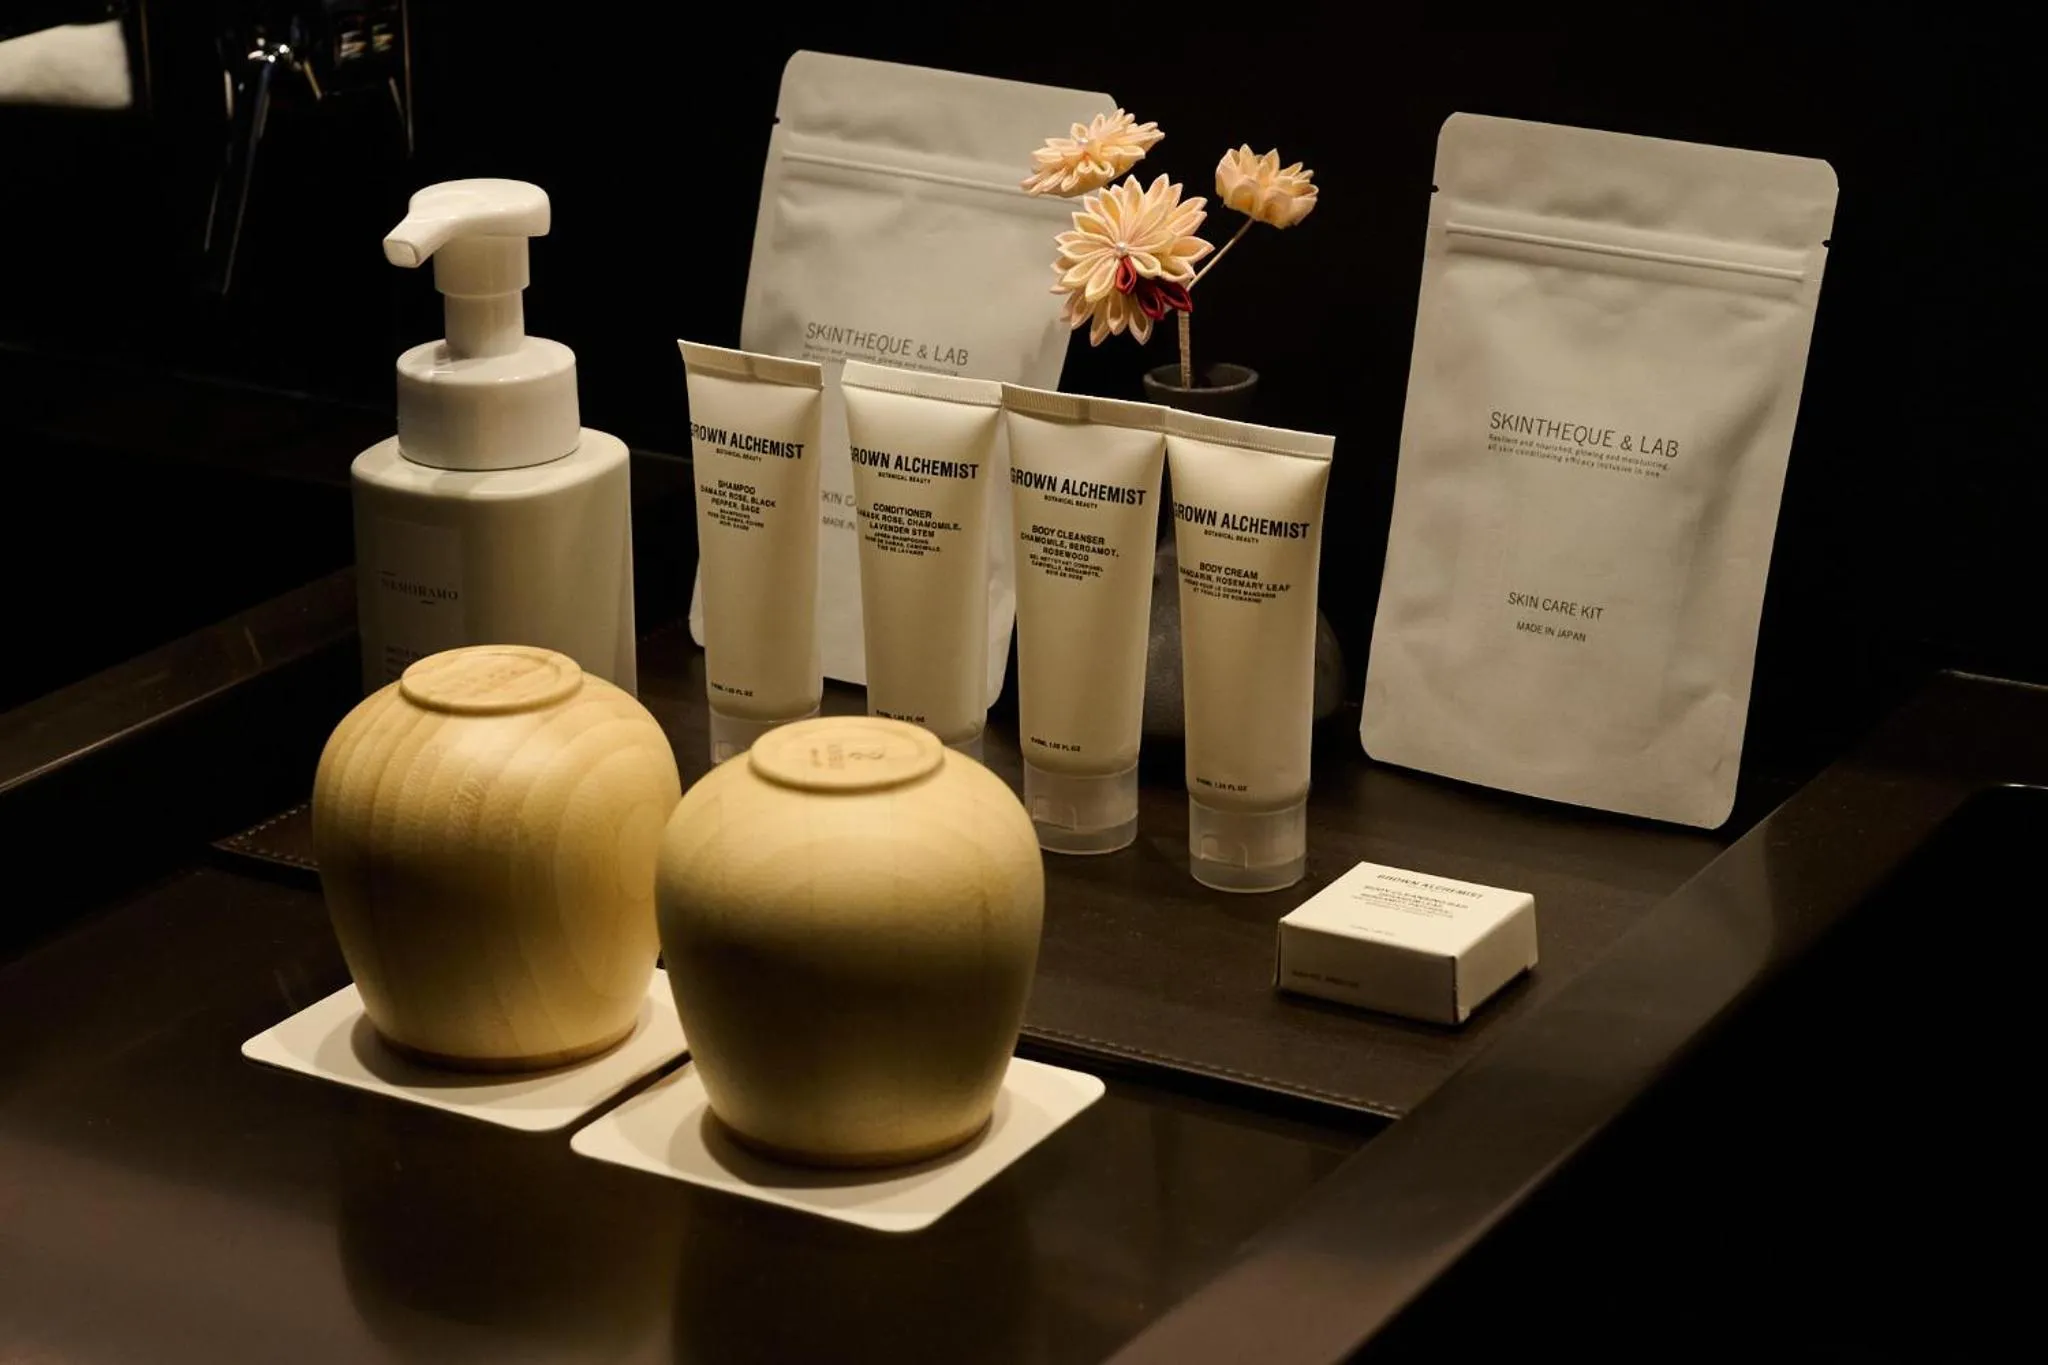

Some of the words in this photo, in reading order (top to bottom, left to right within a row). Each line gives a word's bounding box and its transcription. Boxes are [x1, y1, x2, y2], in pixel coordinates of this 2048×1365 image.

[806, 321, 913, 356] SKINTHEQUE
[917, 343, 928, 359] &
[934, 345, 969, 366] LAB
[690, 422, 728, 445] ROWN
[730, 432, 805, 460] ALCHEMIST
[1490, 411, 1616, 448] SKINTHEQUE
[1620, 434, 1633, 452] &
[1641, 435, 1679, 458] LAB
[851, 444, 890, 469] ROWN
[894, 455, 979, 480] ALCHEMIST
[718, 480, 756, 495] SHAMPOO
[1061, 478, 1147, 506] ALCHEMIST
[751, 496, 777, 509] BLACK
[822, 490, 842, 505] KIN
[1044, 494, 1074, 506] BOTANICAL
[1076, 500, 1098, 510] BEAUTY
[741, 503, 760, 514] SAGE
[873, 503, 933, 520] CONDITIONER
[869, 521, 910, 535] LAVENDER
[912, 528, 935, 538] STEM
[1032, 524, 1056, 537] BODY
[1057, 529, 1105, 545] CLEANSER
[1221, 512, 1310, 539] ALCHEMIST
[1204, 529, 1234, 541] BOTANICAL
[1236, 535, 1260, 544] BEAUTY
[1043, 546, 1089, 562] ROSEWOOD
[1200, 561, 1223, 574] BODY
[1224, 566, 1258, 580] CREAM
[1216, 575, 1264, 590] ROSEMARY
[1266, 583, 1291, 592] LEAF
[1508, 592, 1539, 610] SKIN
[1542, 598, 1578, 616] CARE
[1581, 605, 1604, 622] KIT
[1517, 620, 1543, 635] MADE
[1545, 626, 1555, 637] IN
[1557, 628, 1586, 642] JAPAN
